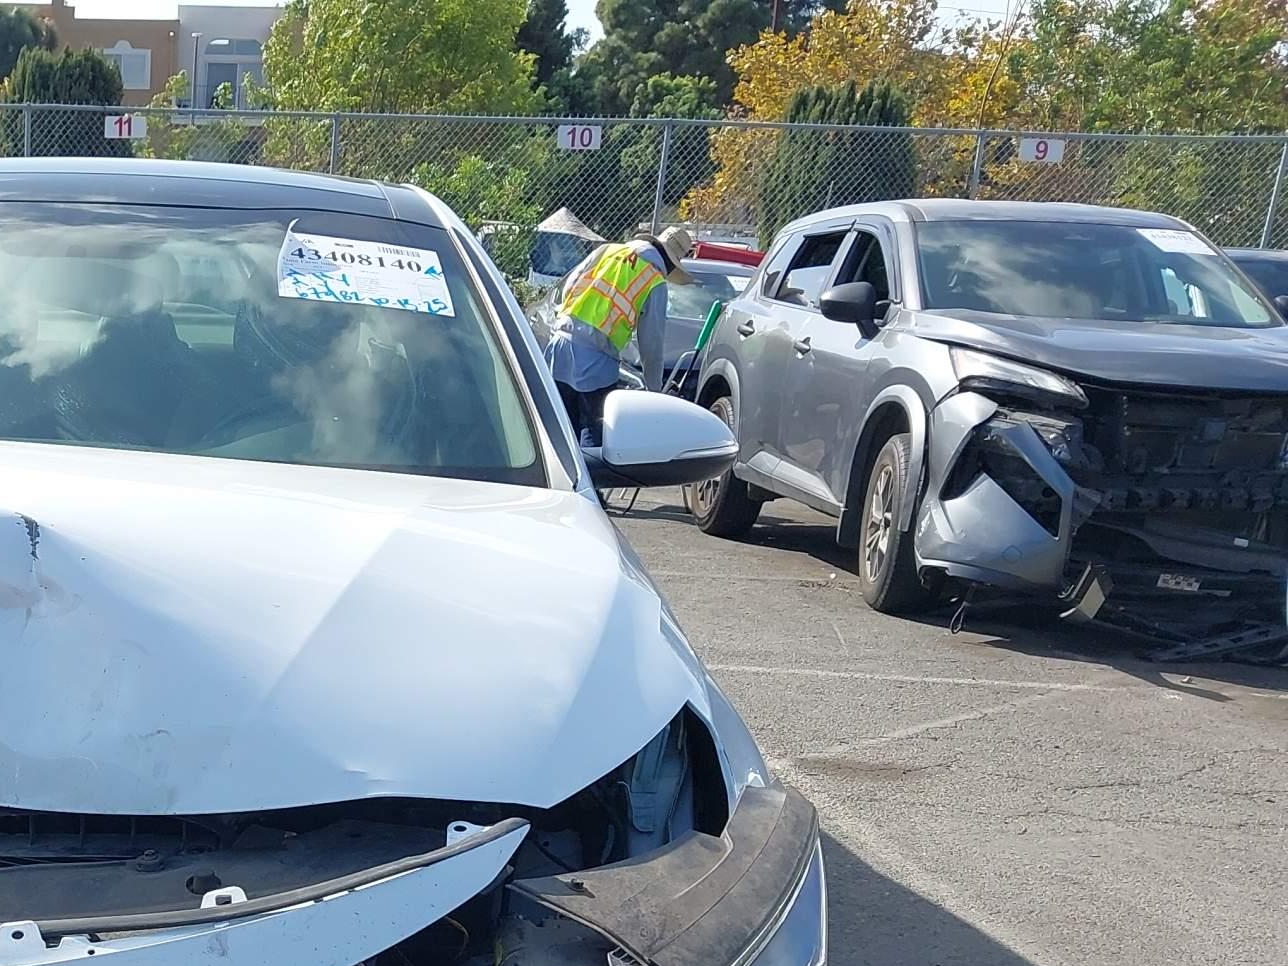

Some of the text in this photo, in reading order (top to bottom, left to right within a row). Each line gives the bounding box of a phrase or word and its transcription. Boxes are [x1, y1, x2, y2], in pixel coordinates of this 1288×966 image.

[114, 117, 132, 136] 11
[568, 127, 592, 147] 10
[1035, 140, 1049, 160] 9
[291, 247, 422, 272] 43408140
